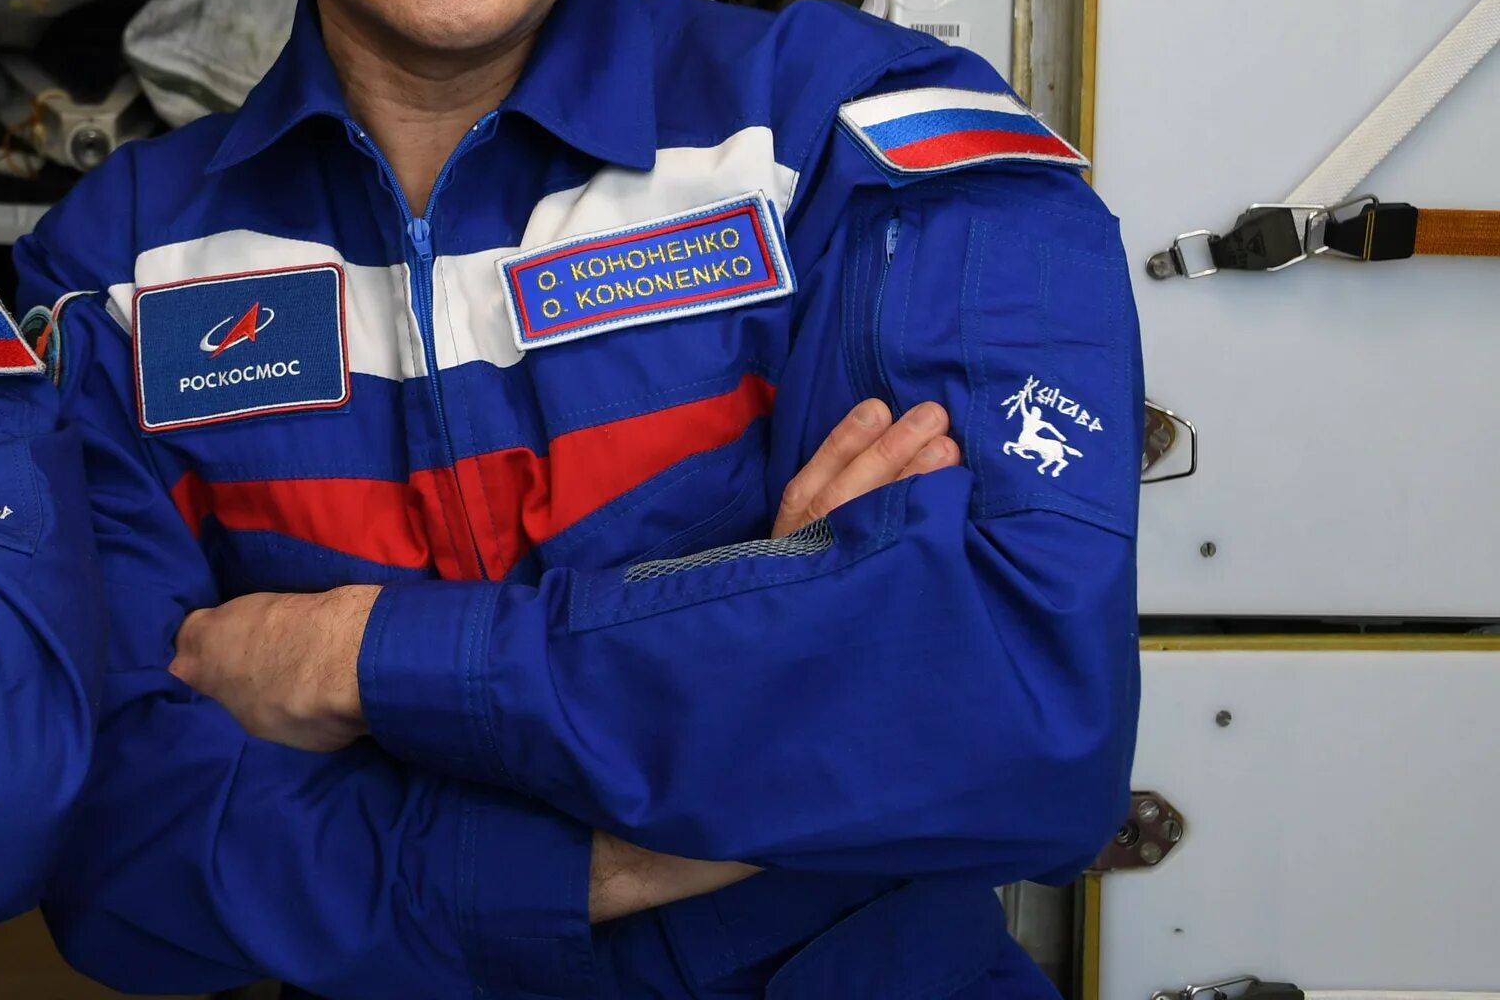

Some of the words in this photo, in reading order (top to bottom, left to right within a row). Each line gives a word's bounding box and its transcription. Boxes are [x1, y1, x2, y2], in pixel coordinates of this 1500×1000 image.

[538, 270, 564, 291] О.
[570, 227, 740, 281] КОНОНЕНКО
[542, 299, 569, 318] O.
[575, 255, 752, 309] KONONENKO
[179, 360, 301, 393] РОСКОСМОС
